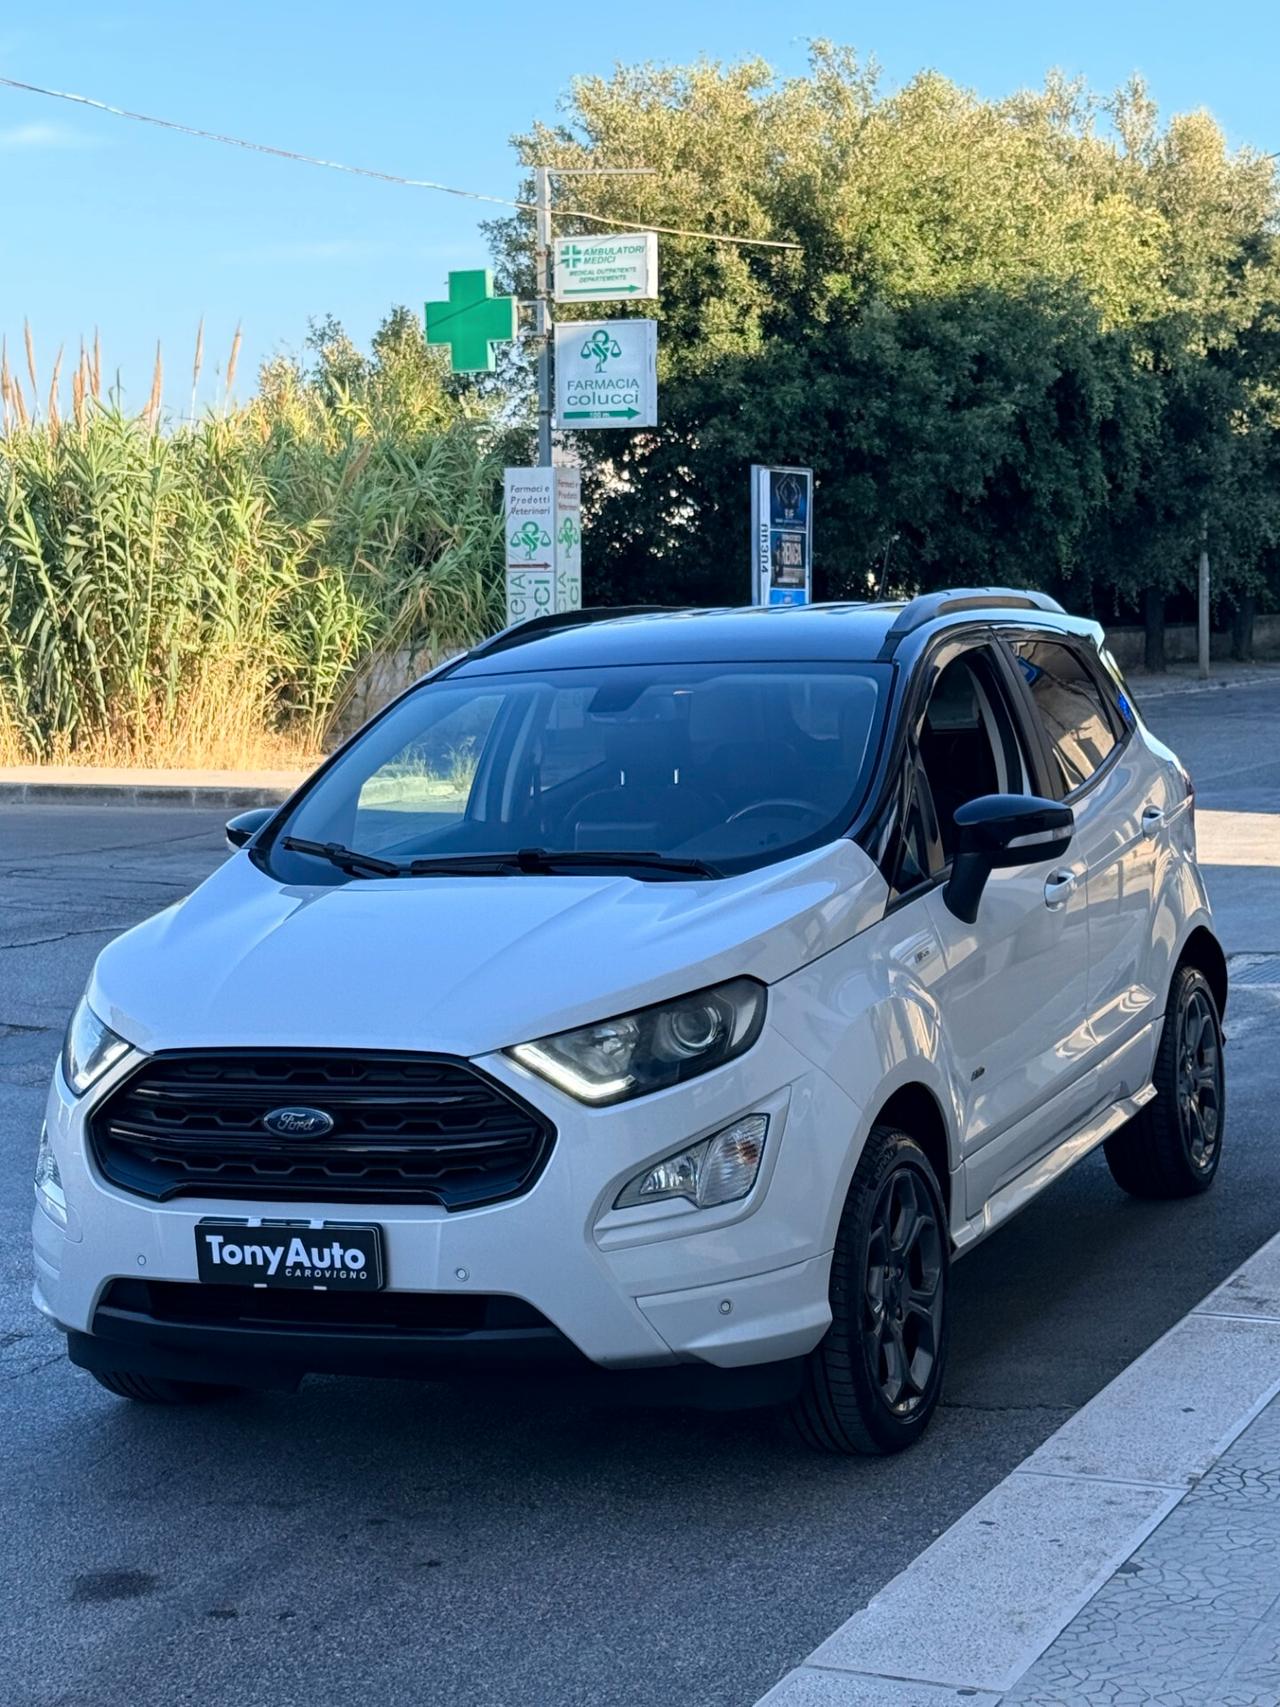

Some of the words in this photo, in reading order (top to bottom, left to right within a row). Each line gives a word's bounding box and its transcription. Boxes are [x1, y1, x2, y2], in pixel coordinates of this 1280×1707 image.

[583, 245, 645, 256] AMBULATORI
[583, 256, 617, 265] MEDICI
[567, 378, 640, 391] FARMACIA
[567, 390, 639, 406] colucci
[510, 484, 543, 494] Farmaci
[510, 495, 550, 505] Prodotti
[510, 506, 550, 516] Veterinari
[276, 1111, 316, 1131] Ford
[285, 1267, 368, 1280] CAROVIGNO
